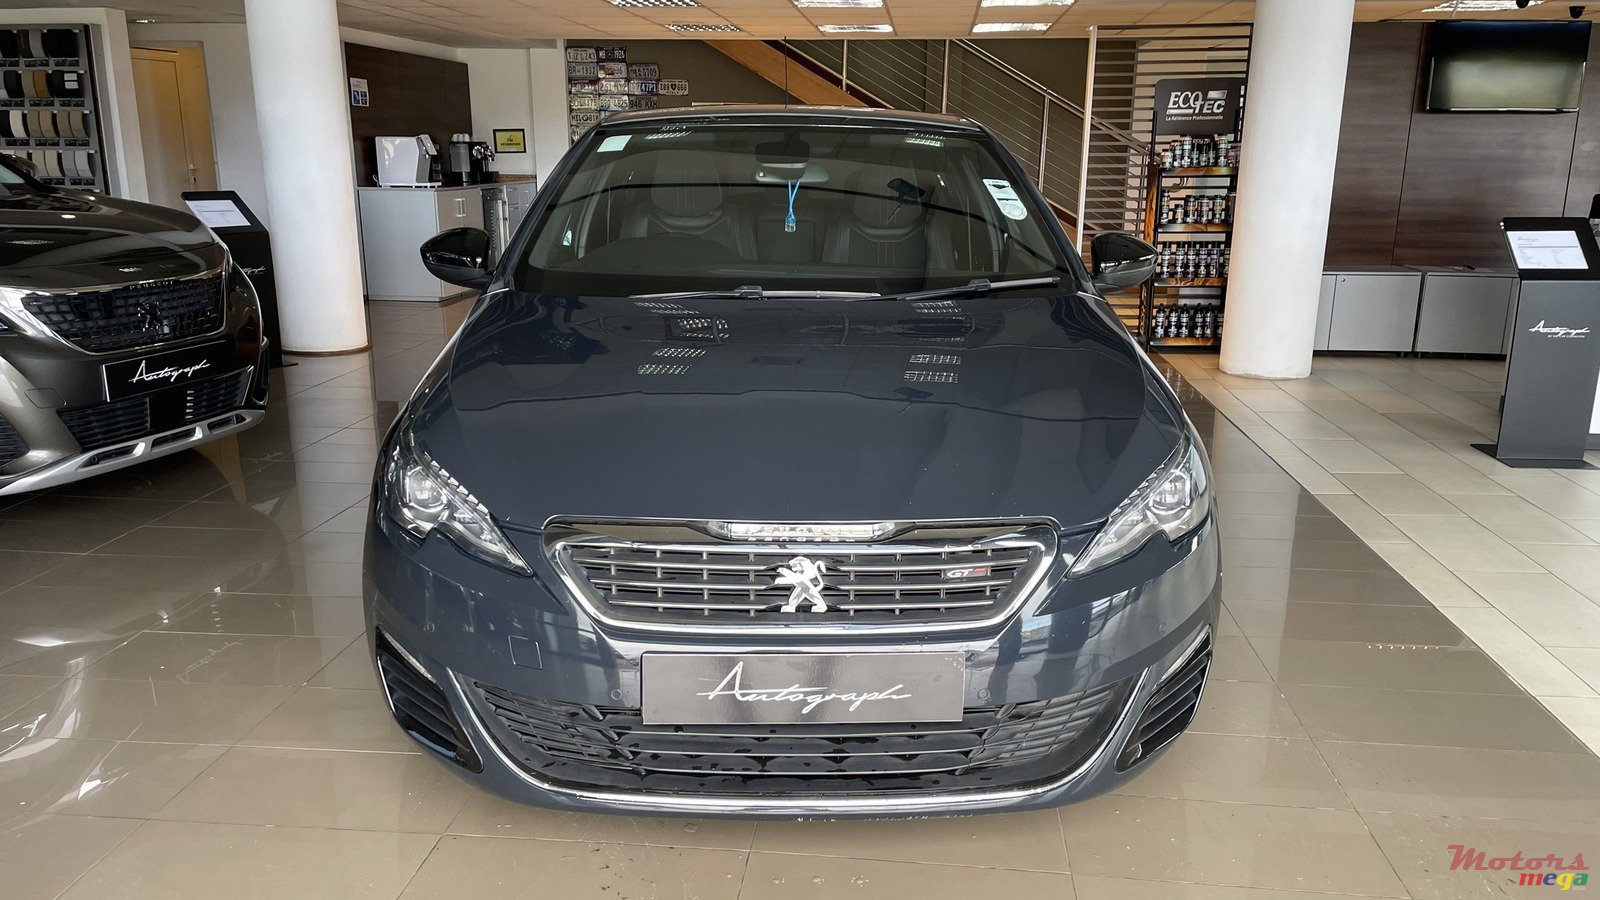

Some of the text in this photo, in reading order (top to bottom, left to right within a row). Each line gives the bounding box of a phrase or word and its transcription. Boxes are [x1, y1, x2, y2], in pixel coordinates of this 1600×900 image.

[128, 359, 211, 383] Autograph
[946, 568, 975, 578] GT
[696, 661, 912, 714] Autograph
